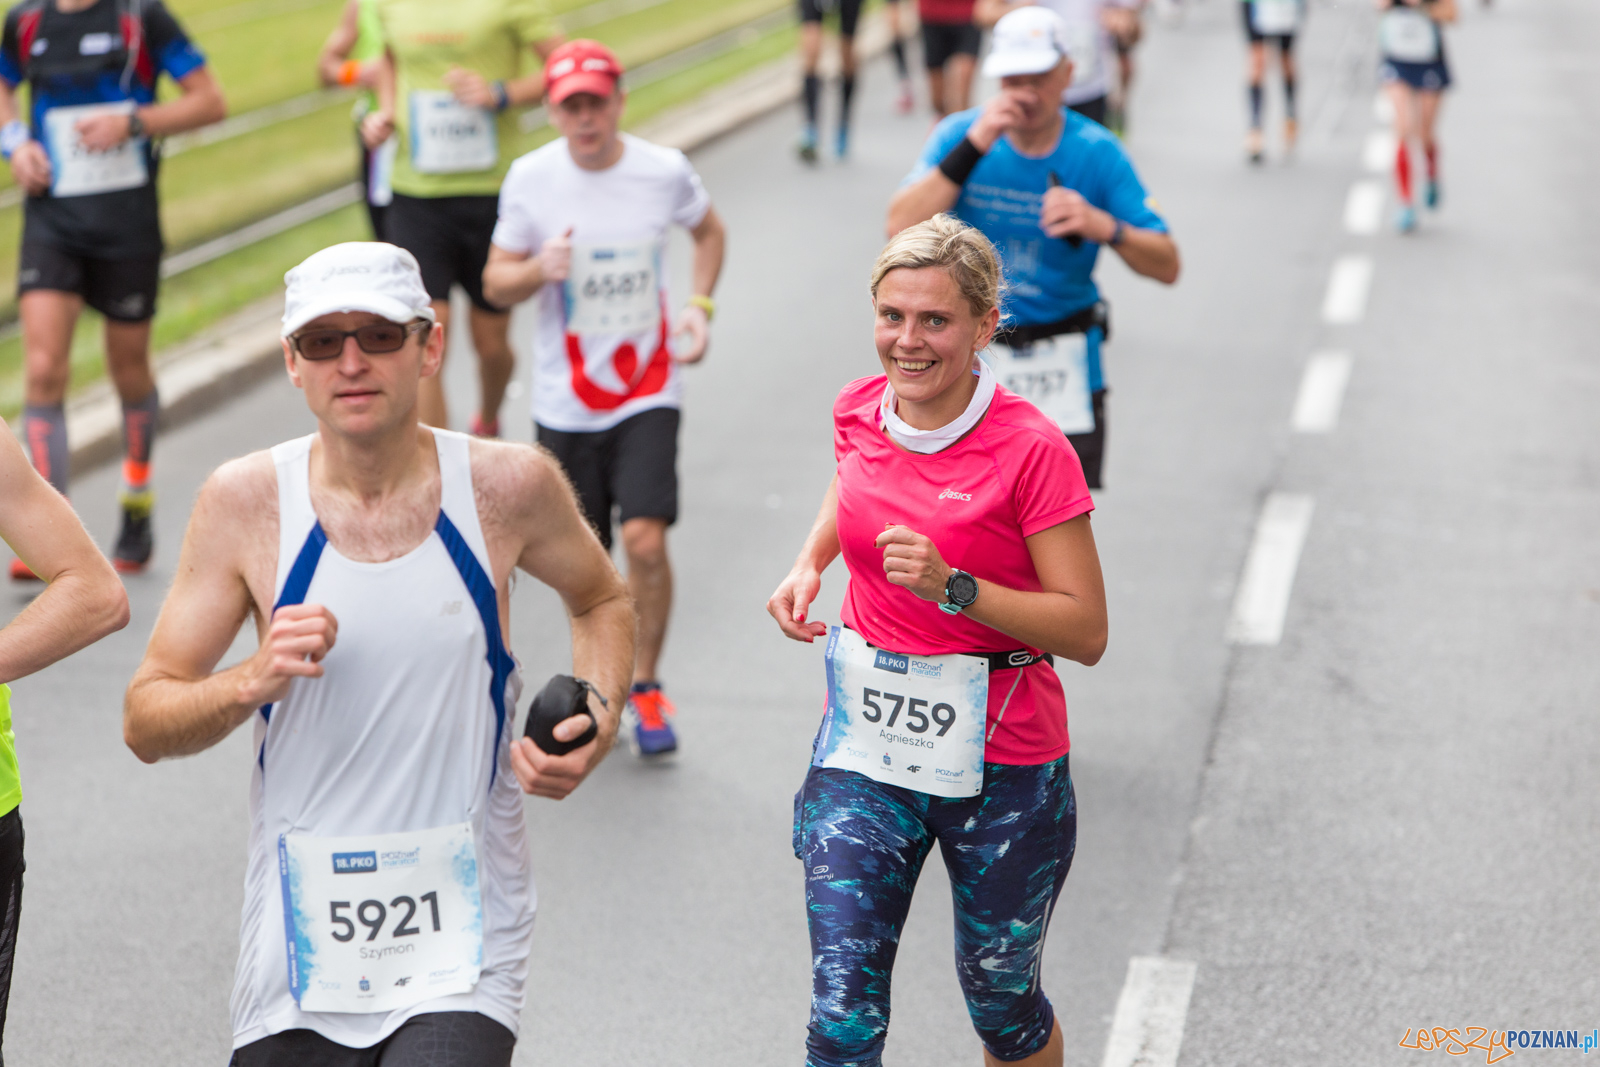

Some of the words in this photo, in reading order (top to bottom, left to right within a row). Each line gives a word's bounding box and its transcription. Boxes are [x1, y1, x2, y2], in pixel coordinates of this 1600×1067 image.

[583, 271, 651, 299] 6587
[1006, 370, 1068, 395] 5757
[944, 489, 972, 501] asics
[911, 667, 941, 677] maraton
[862, 687, 956, 737] 5759
[879, 729, 934, 749] Agnieszka
[906, 764, 922, 774] 4F
[329, 891, 441, 943] 5921
[359, 943, 415, 960] Szymon
